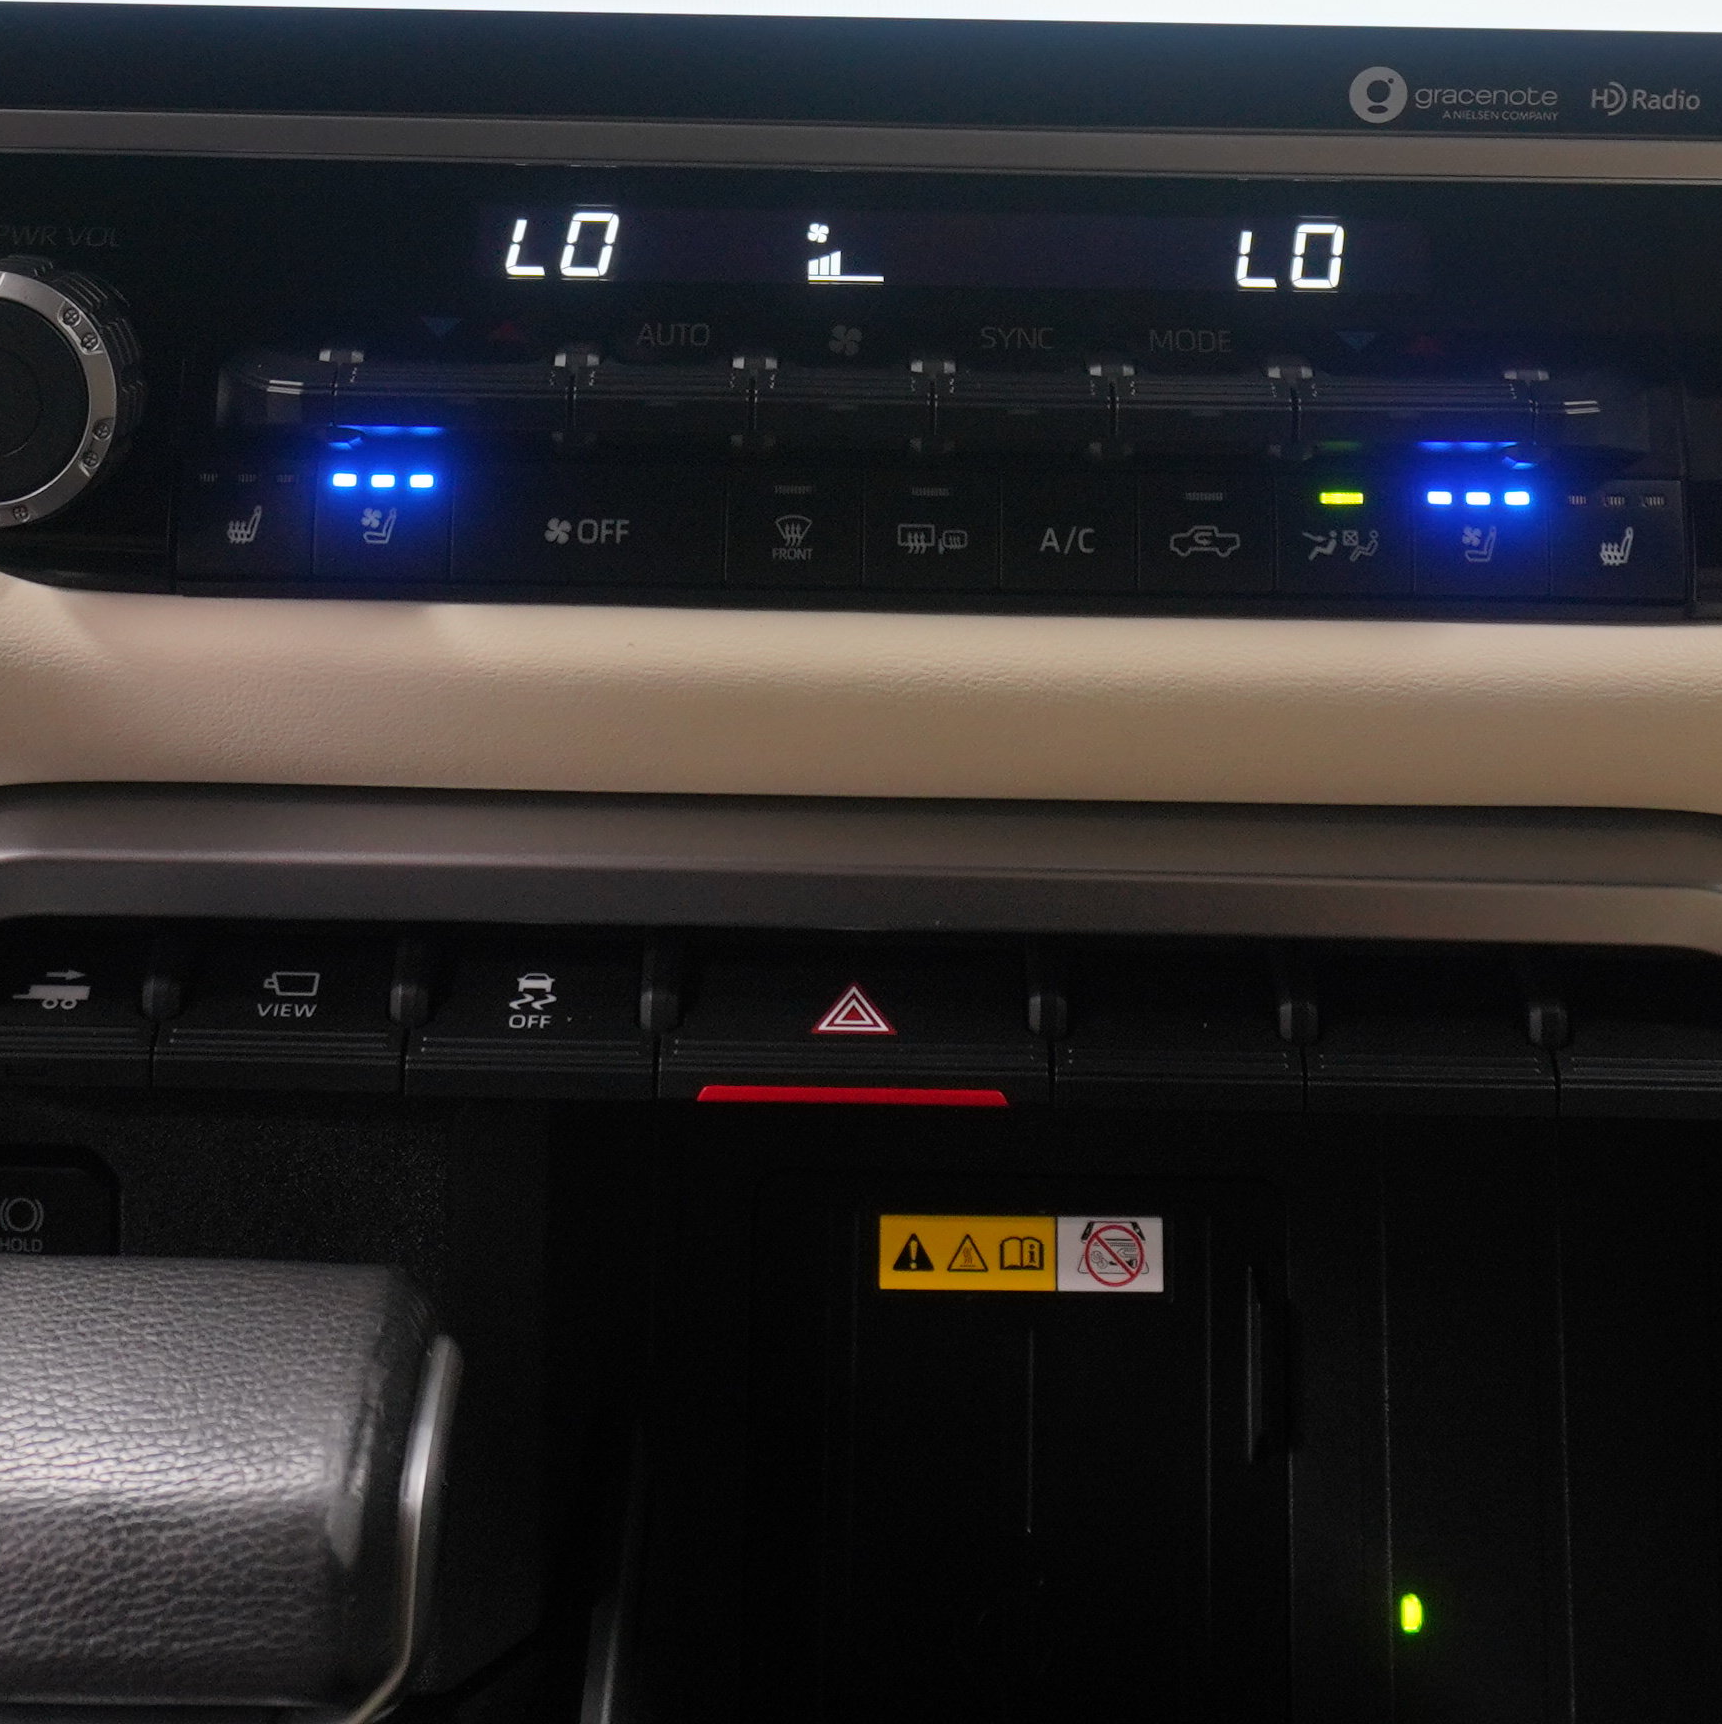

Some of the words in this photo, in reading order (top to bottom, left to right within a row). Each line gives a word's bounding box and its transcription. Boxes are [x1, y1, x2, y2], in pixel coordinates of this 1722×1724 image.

[1415, 87, 1558, 109] gracenote
[1633, 90, 1700, 111] Radio
[1452, 111, 1499, 120] NIELSEN
[1501, 111, 1558, 121] COMPANY
[505, 213, 619, 277] LO
[1237, 223, 1344, 289] LO
[637, 323, 709, 346] AUTO
[980, 327, 1055, 351] SYNC
[1149, 328, 1232, 354] MODE
[577, 518, 629, 545] OFF
[1039, 527, 1095, 555] A/C
[772, 547, 813, 561] FRONT
[257, 1003, 317, 1019] VIEW
[509, 1014, 551, 1030] OFF
[0, 1237, 43, 1253] HOLD
